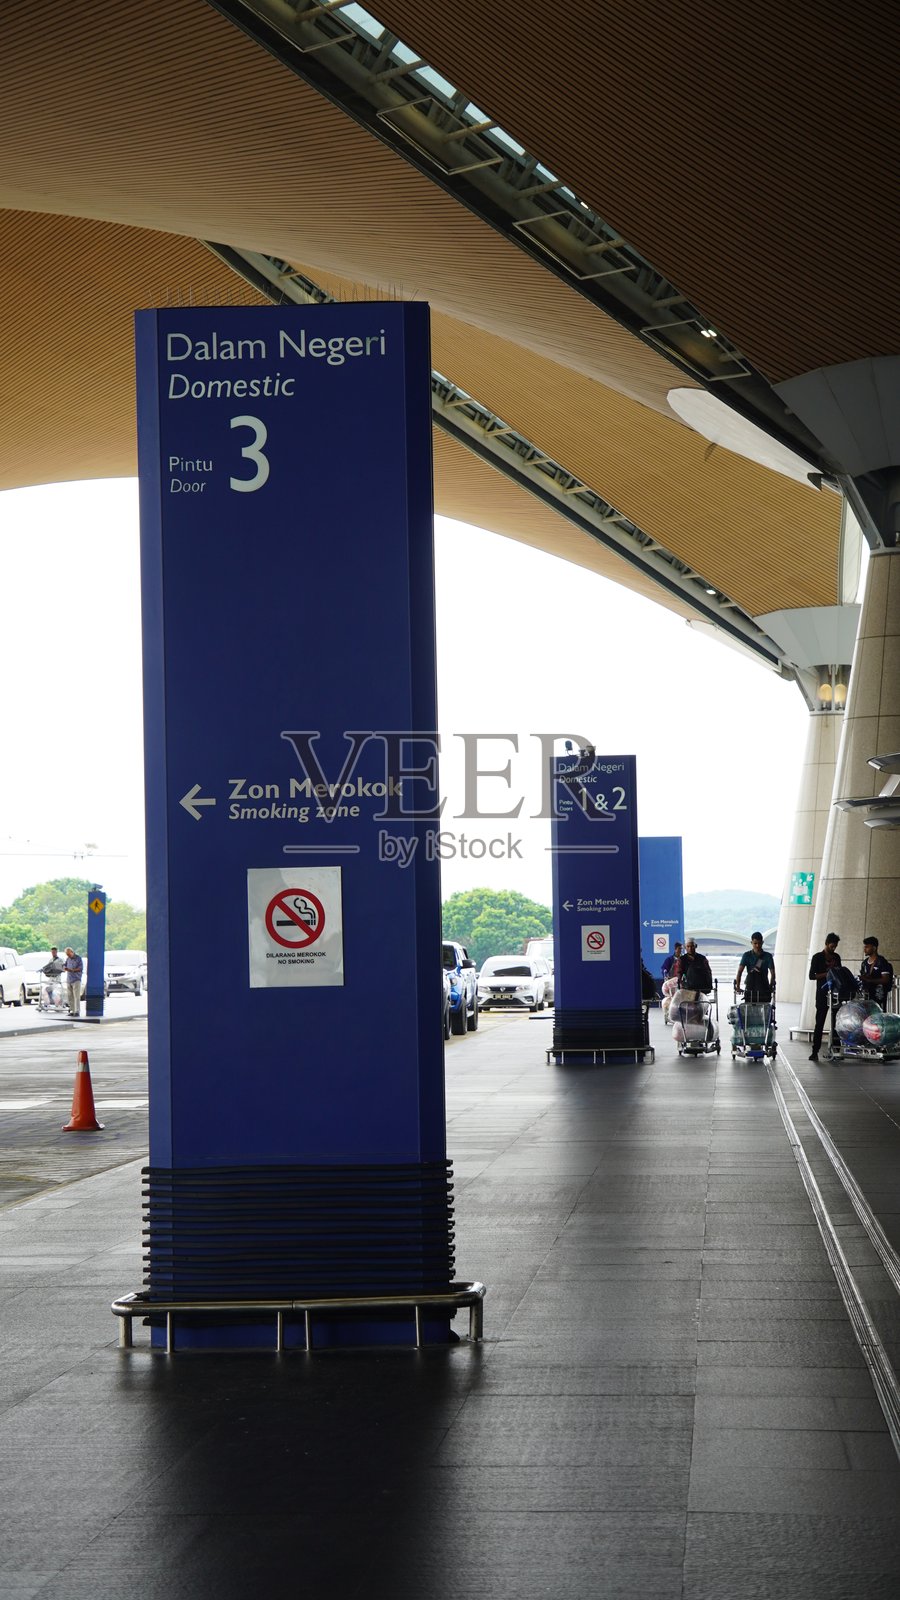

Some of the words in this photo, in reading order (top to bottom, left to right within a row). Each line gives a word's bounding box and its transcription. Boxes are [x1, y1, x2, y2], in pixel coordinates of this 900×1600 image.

[167, 332, 266, 361] Dalam
[279, 329, 386, 366] Negeri
[168, 372, 295, 399] Domestic
[169, 456, 213, 472] Pintu
[230, 415, 270, 493] 3
[170, 478, 206, 493] Door
[558, 763, 589, 773] Dalam
[591, 762, 625, 774] Negeri
[228, 779, 284, 800] Zon
[289, 777, 404, 799] Merokok
[559, 775, 598, 783] Domestic
[578, 787, 587, 811] 1
[595, 793, 608, 811] &
[612, 786, 627, 810] 2
[228, 803, 310, 823] Smoking
[316, 805, 360, 819] zone
[595, 898, 629, 906] Merokok
